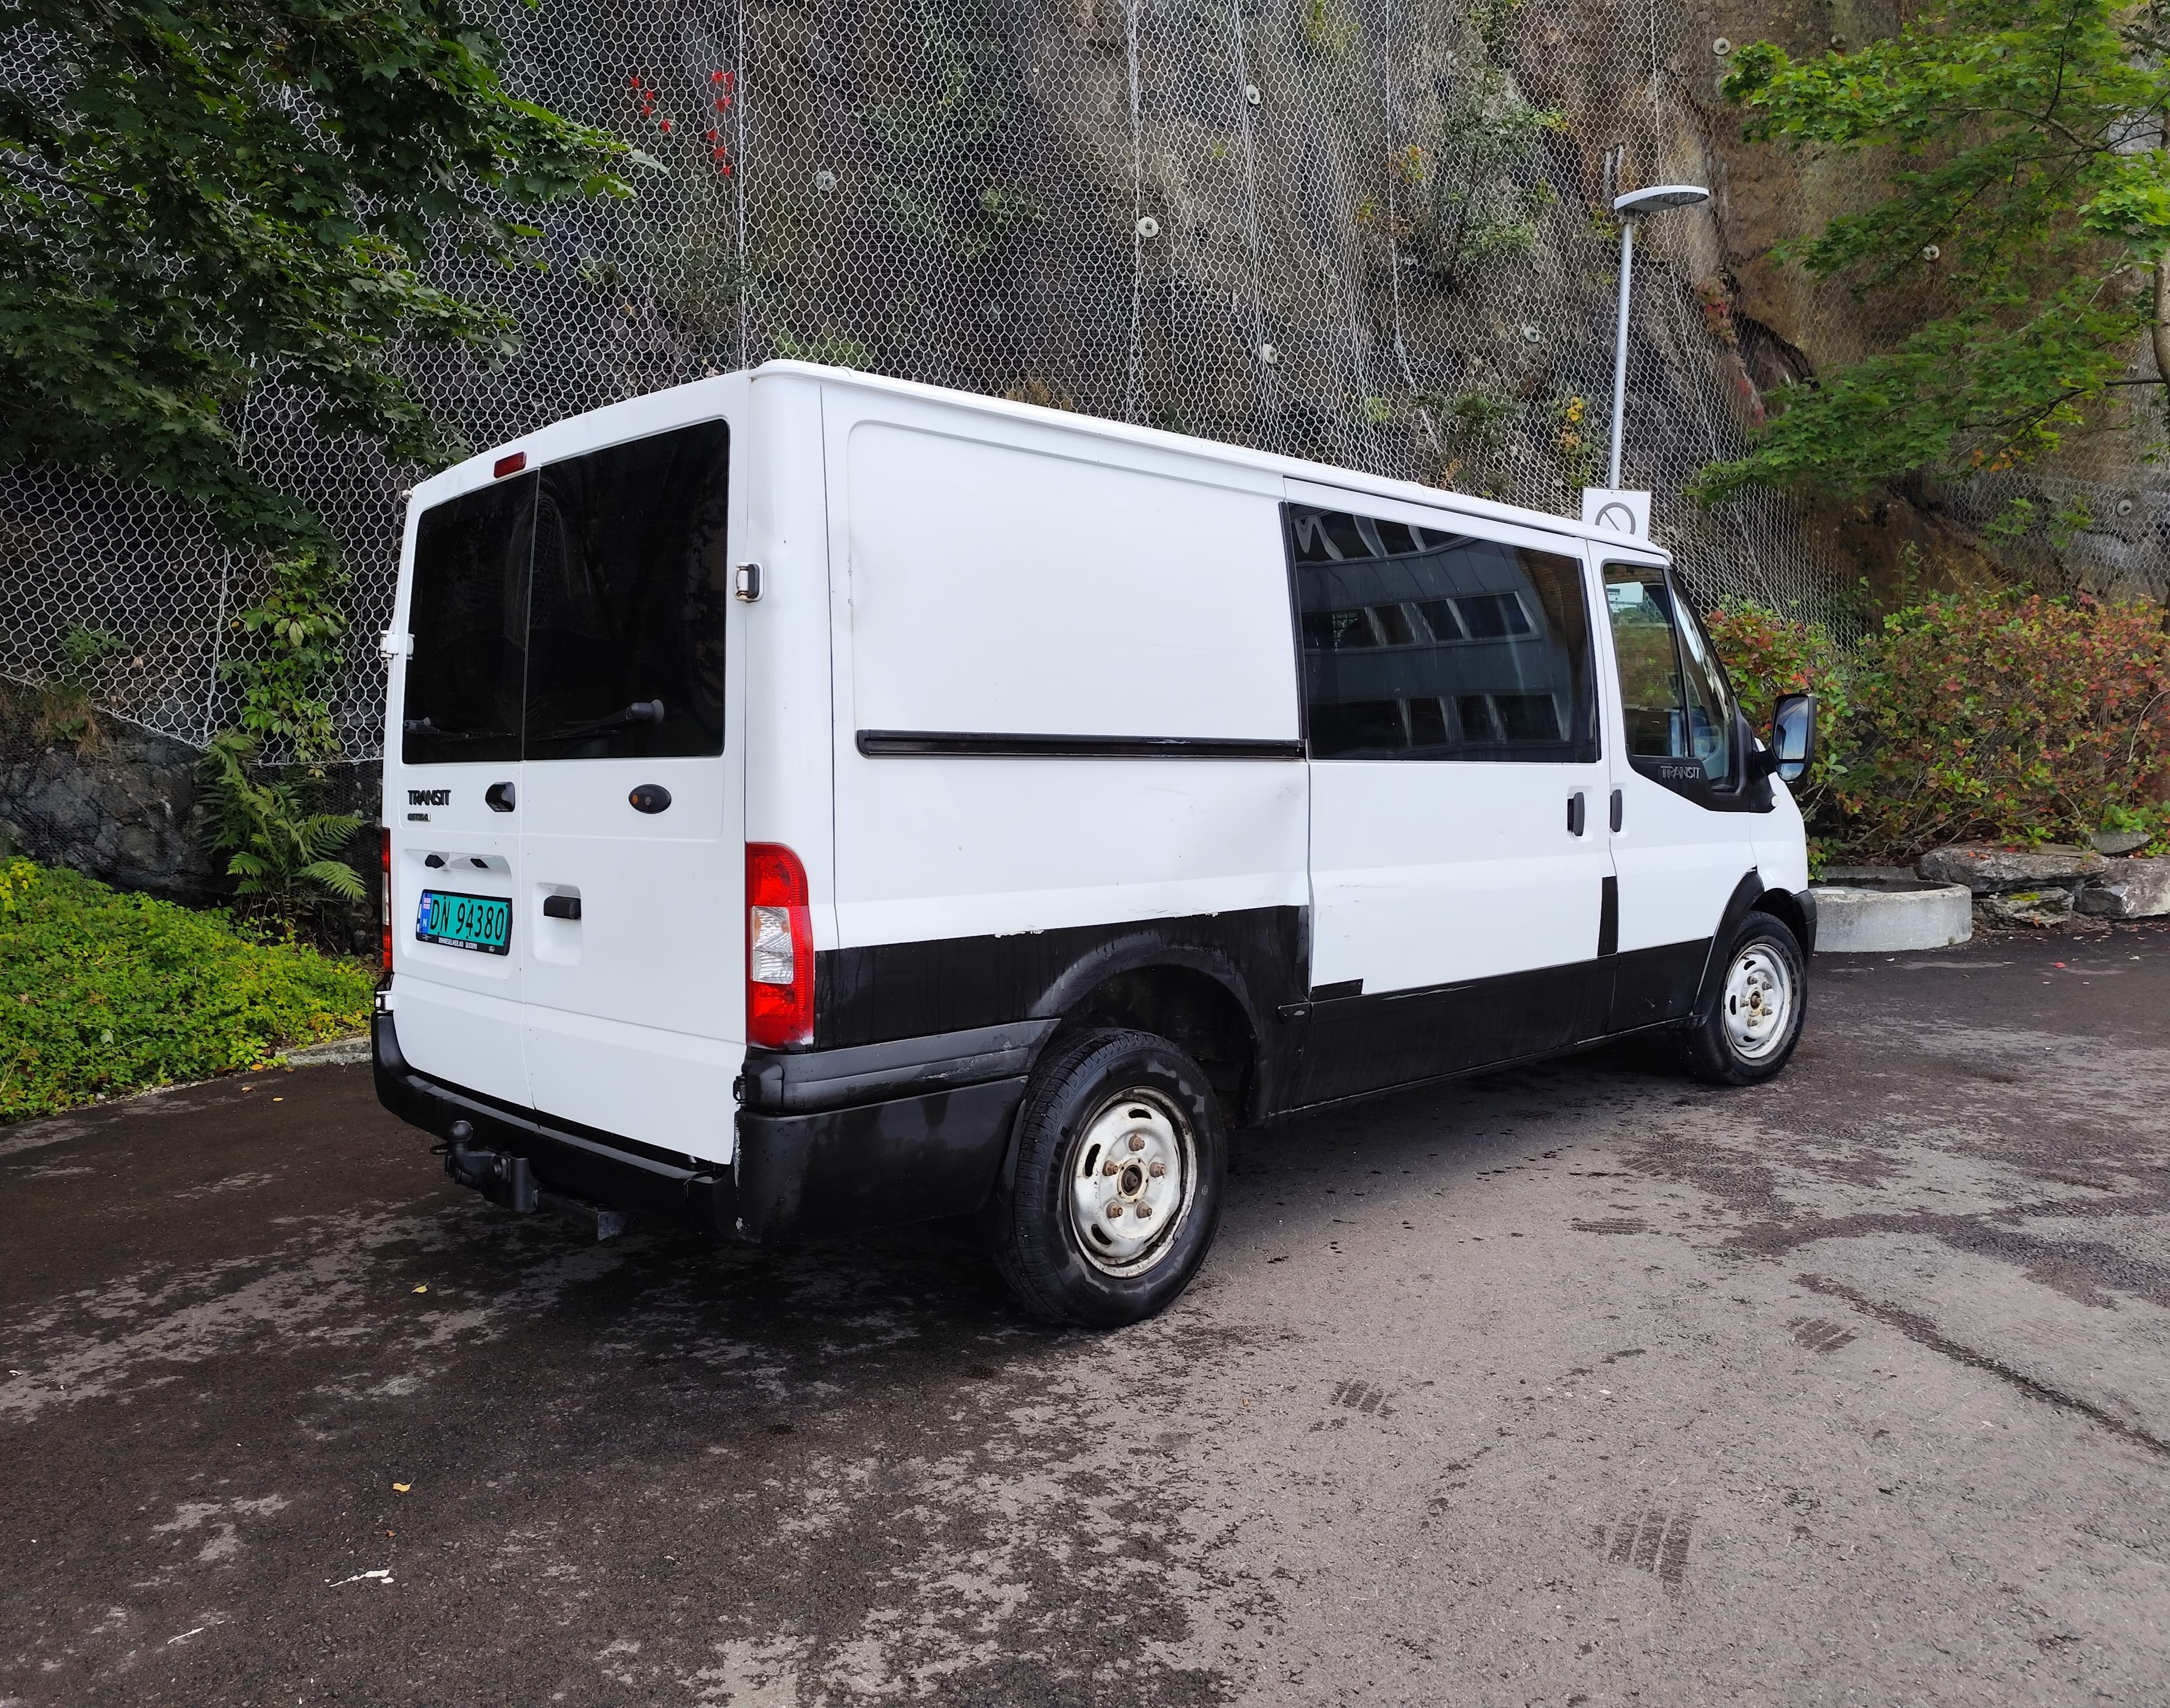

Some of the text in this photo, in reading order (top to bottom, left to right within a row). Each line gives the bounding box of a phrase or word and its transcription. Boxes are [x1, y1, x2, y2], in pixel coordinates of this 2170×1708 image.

[1660, 766, 1701, 779] TRANSIT
[407, 789, 452, 806] TRANSIT
[422, 918, 428, 927] N
[430, 899, 505, 941] DN 94380
